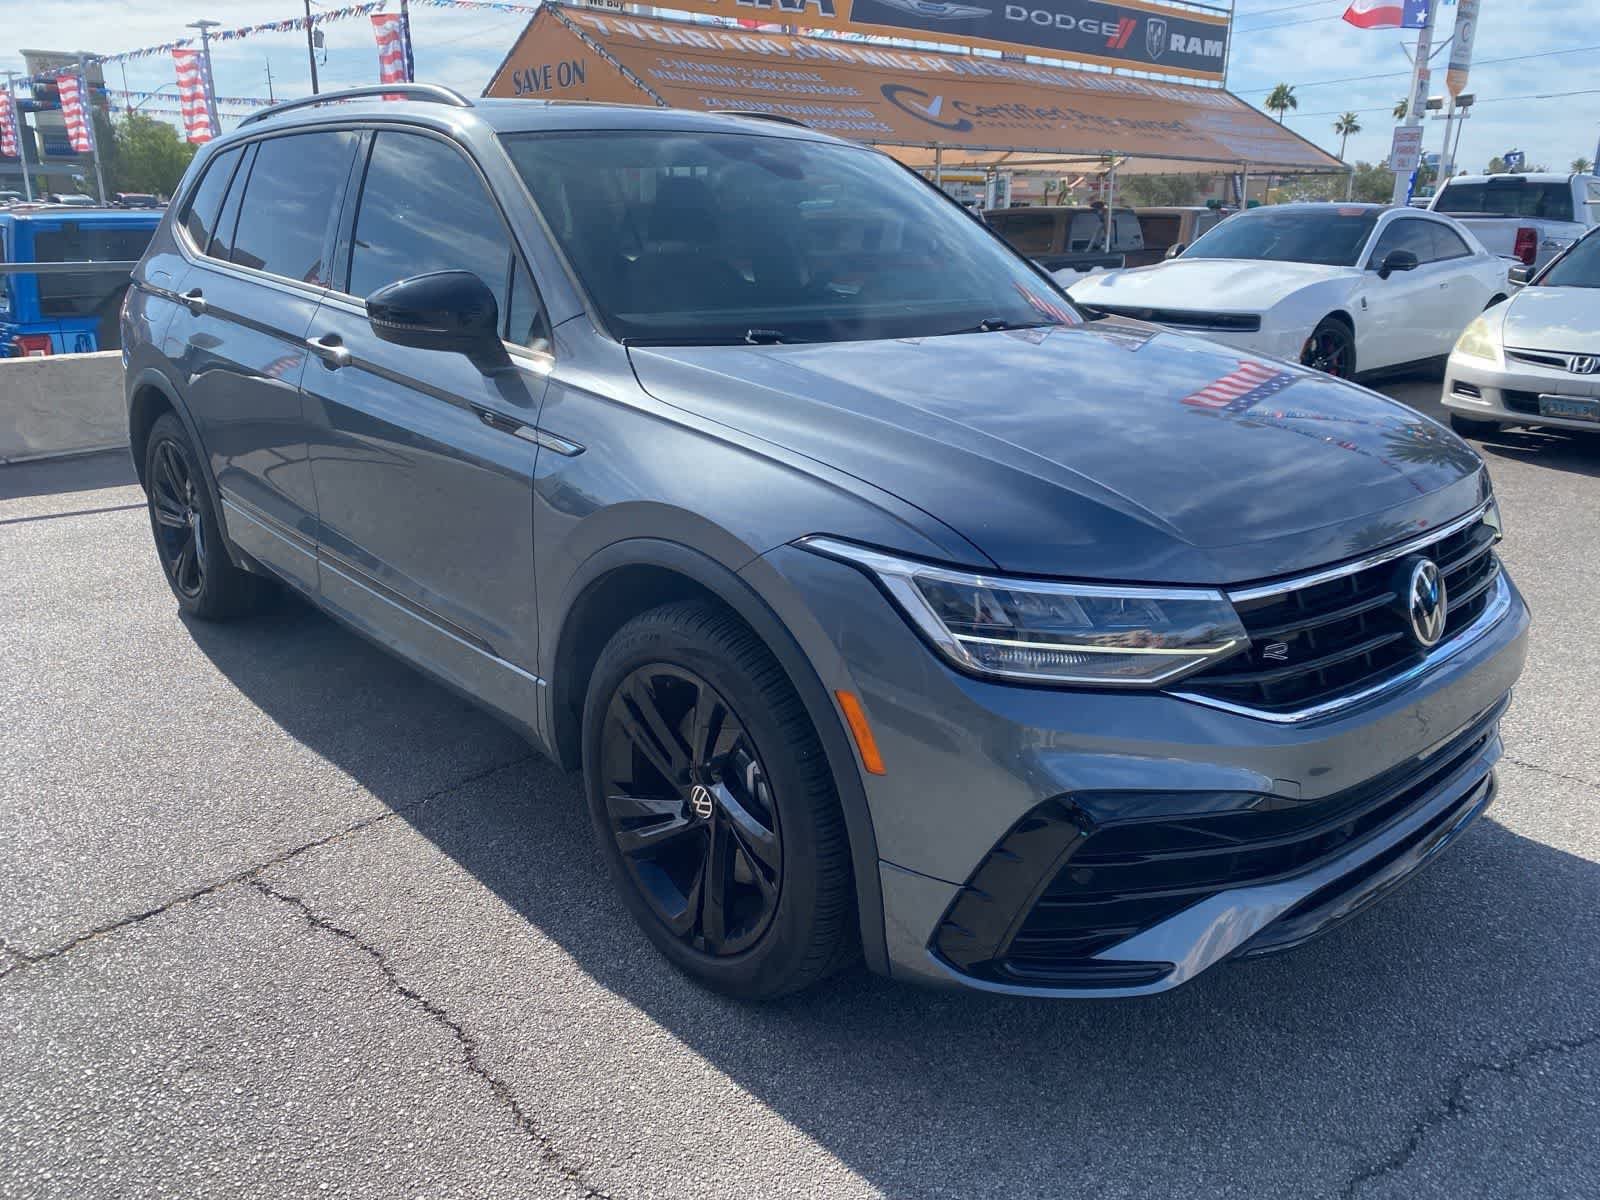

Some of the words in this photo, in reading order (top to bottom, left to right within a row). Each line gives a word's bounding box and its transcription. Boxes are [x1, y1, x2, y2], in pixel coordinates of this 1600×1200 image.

[1005, 6, 1123, 37] DODGE
[1170, 34, 1222, 57] RAM
[512, 64, 553, 96] SAVE
[557, 59, 585, 88] ON
